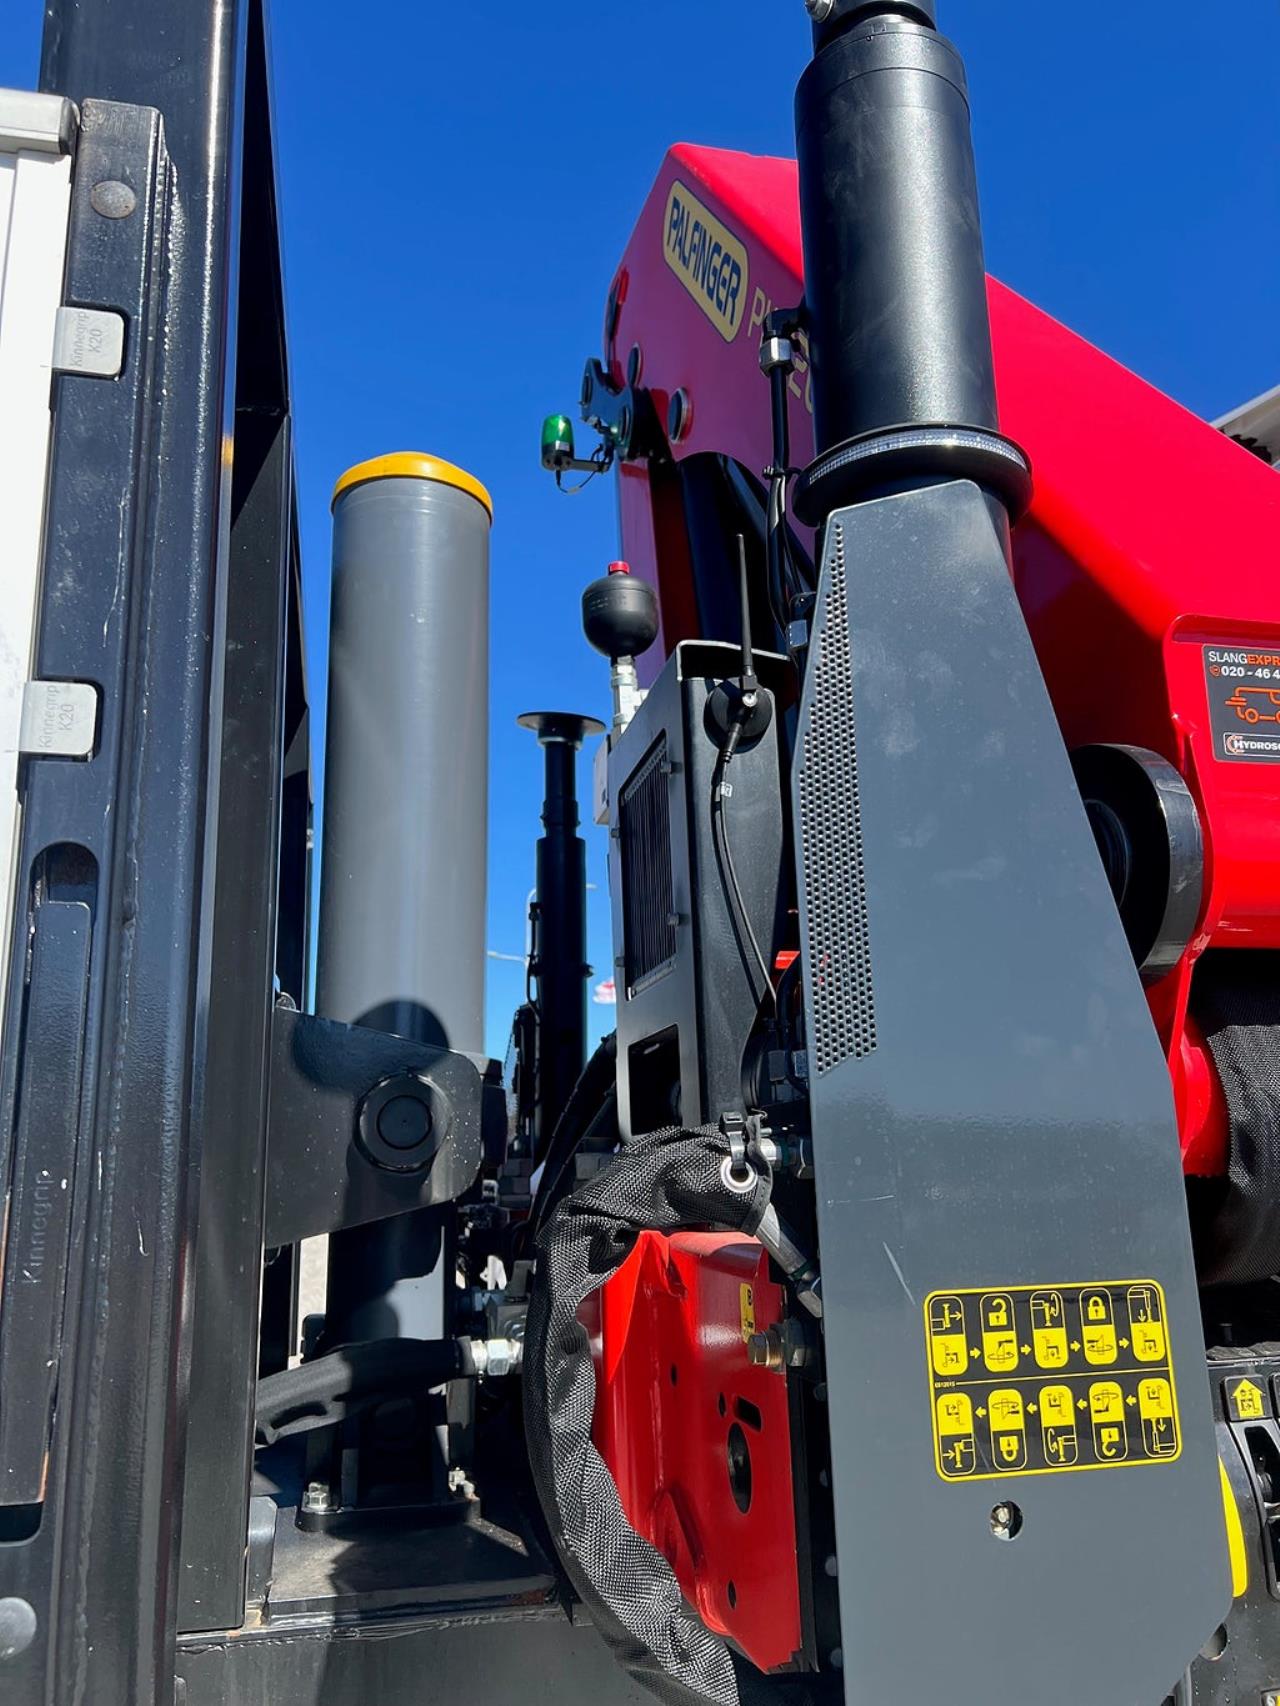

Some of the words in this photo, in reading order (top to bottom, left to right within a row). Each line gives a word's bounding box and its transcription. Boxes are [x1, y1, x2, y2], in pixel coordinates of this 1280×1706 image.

[666, 196, 742, 326] PALFINGER
[69, 310, 89, 367] Kinnegrip
[88, 329, 103, 353] K20
[1221, 666, 1245, 677] 020
[1255, 668, 1271, 679] 46
[38, 685, 60, 747] Kinnegrip
[58, 704, 74, 730] K20
[1233, 740, 1280, 751] HYDROS
[22, 1171, 55, 1283] Kinnegrip
